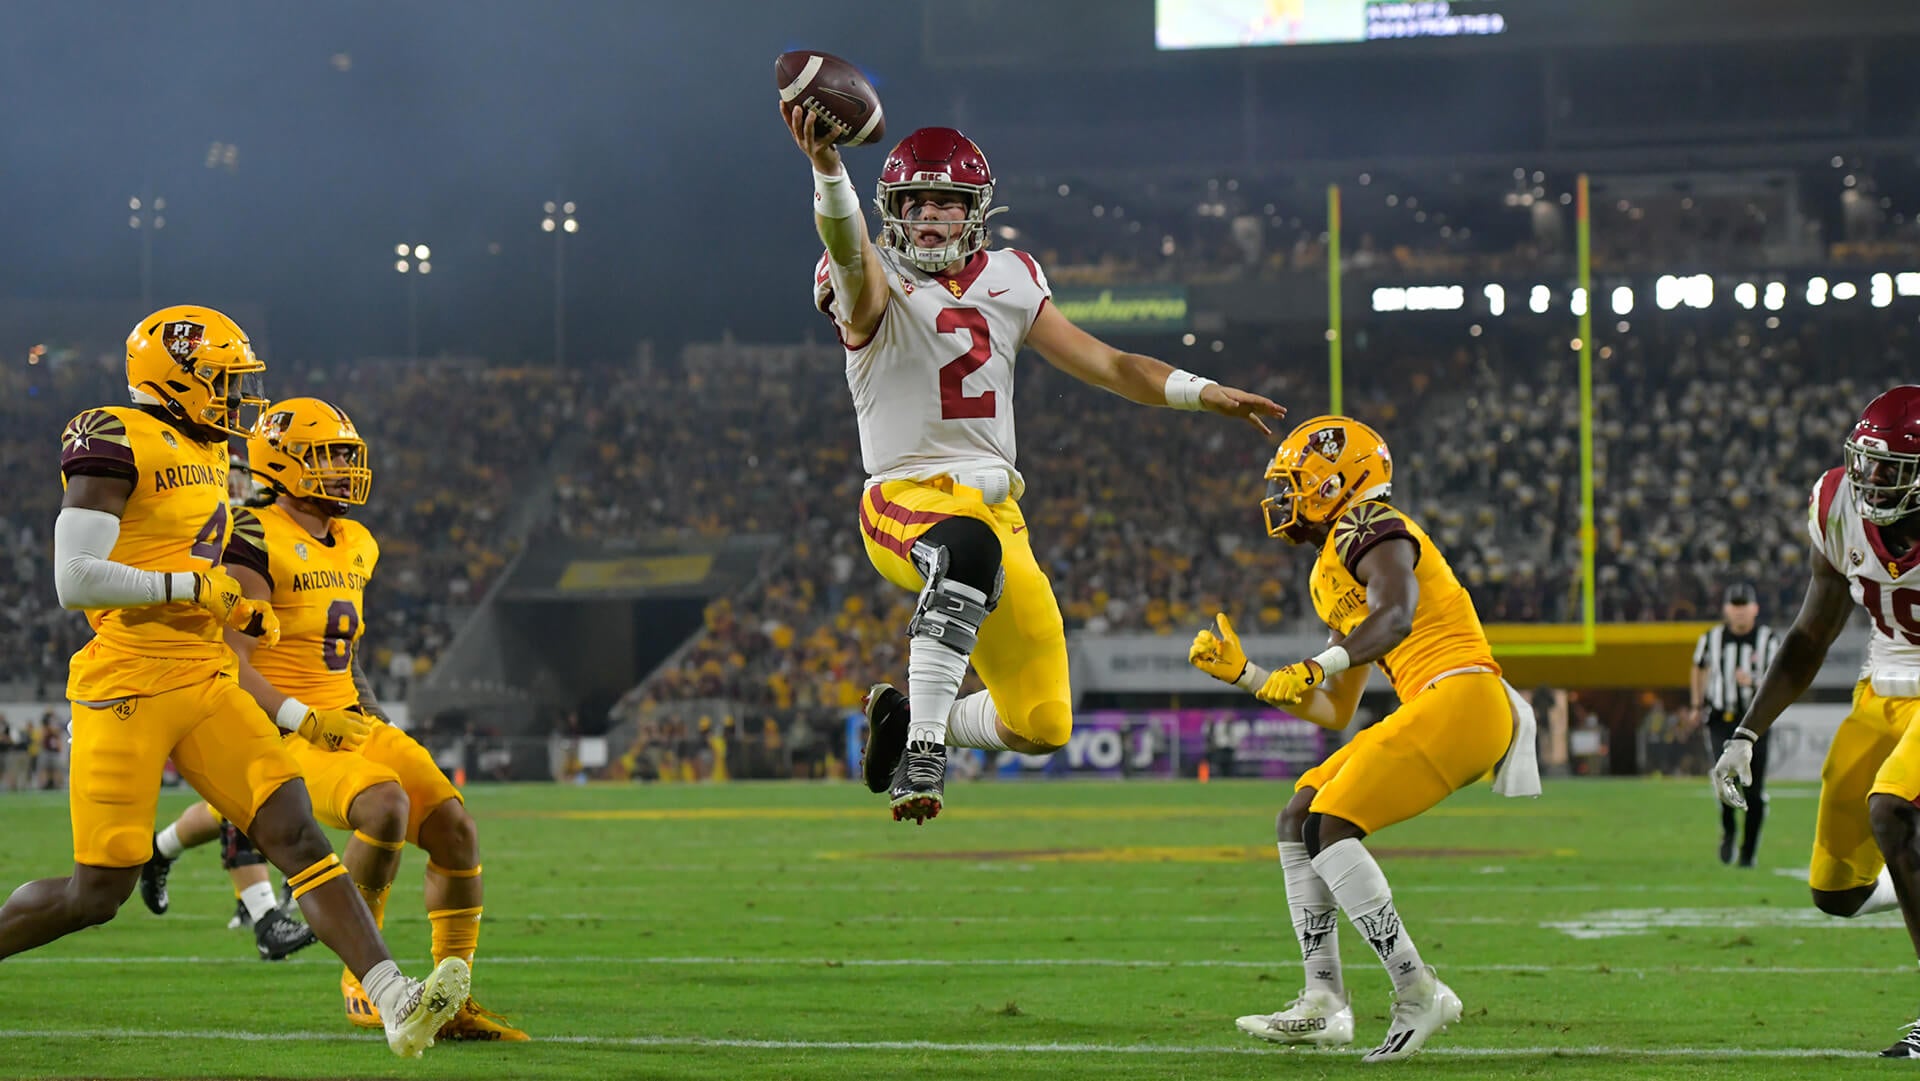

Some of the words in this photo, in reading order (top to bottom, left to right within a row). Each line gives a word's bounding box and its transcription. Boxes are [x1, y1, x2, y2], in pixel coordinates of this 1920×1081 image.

[173, 324, 192, 337] PT
[171, 340, 190, 354] 42
[935, 307, 997, 420] 2
[1319, 429, 1335, 442] PT
[1322, 442, 1339, 455] 42
[155, 464, 216, 493] ARIZONA
[189, 500, 228, 569] 4
[293, 570, 346, 593] ARIZONA
[322, 600, 359, 672] 8
[116, 704, 130, 715] 42
[1266, 1016, 1327, 1032] ADIZERO
